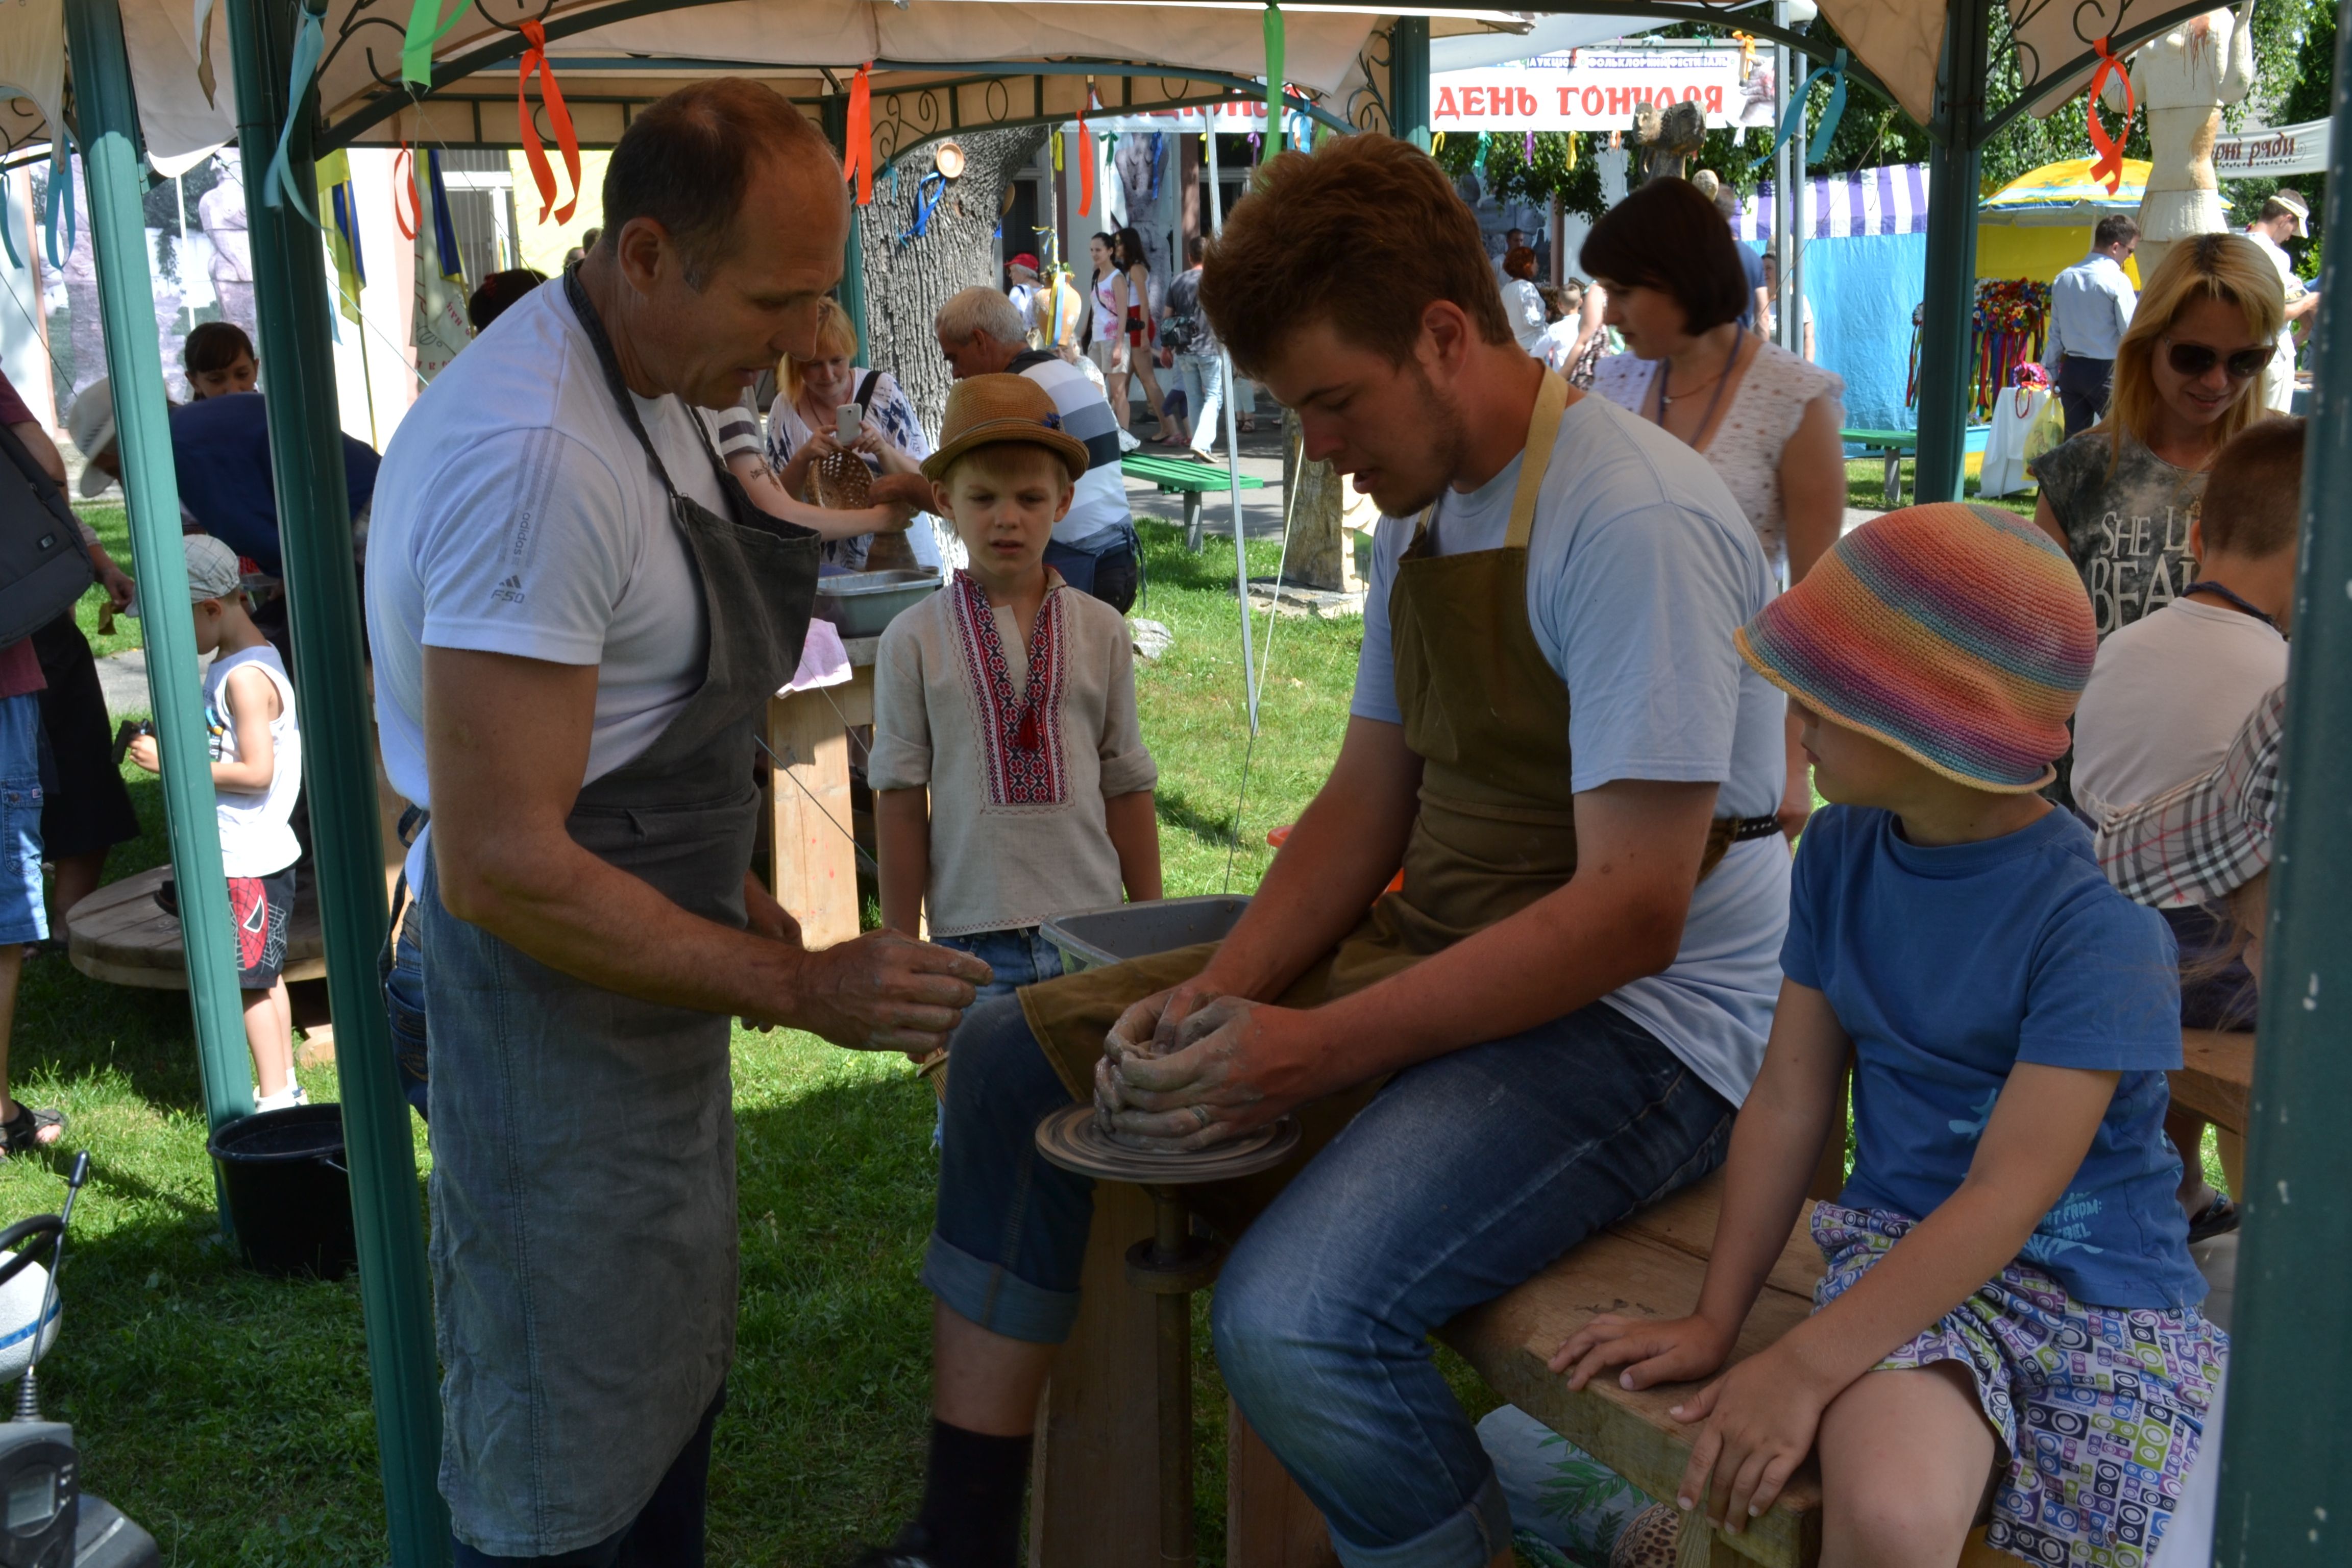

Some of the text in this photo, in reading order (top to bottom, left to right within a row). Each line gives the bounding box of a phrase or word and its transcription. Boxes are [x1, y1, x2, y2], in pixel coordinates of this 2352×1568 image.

[1529, 57, 1577, 68] АУКЦІО
[1434, 85, 1723, 120] ДЕНЬ ГОНЧАРЯ
[2211, 131, 2295, 167] рні ряди
[513, 512, 531, 555] adidas
[2099, 505, 2196, 558] SHE LI
